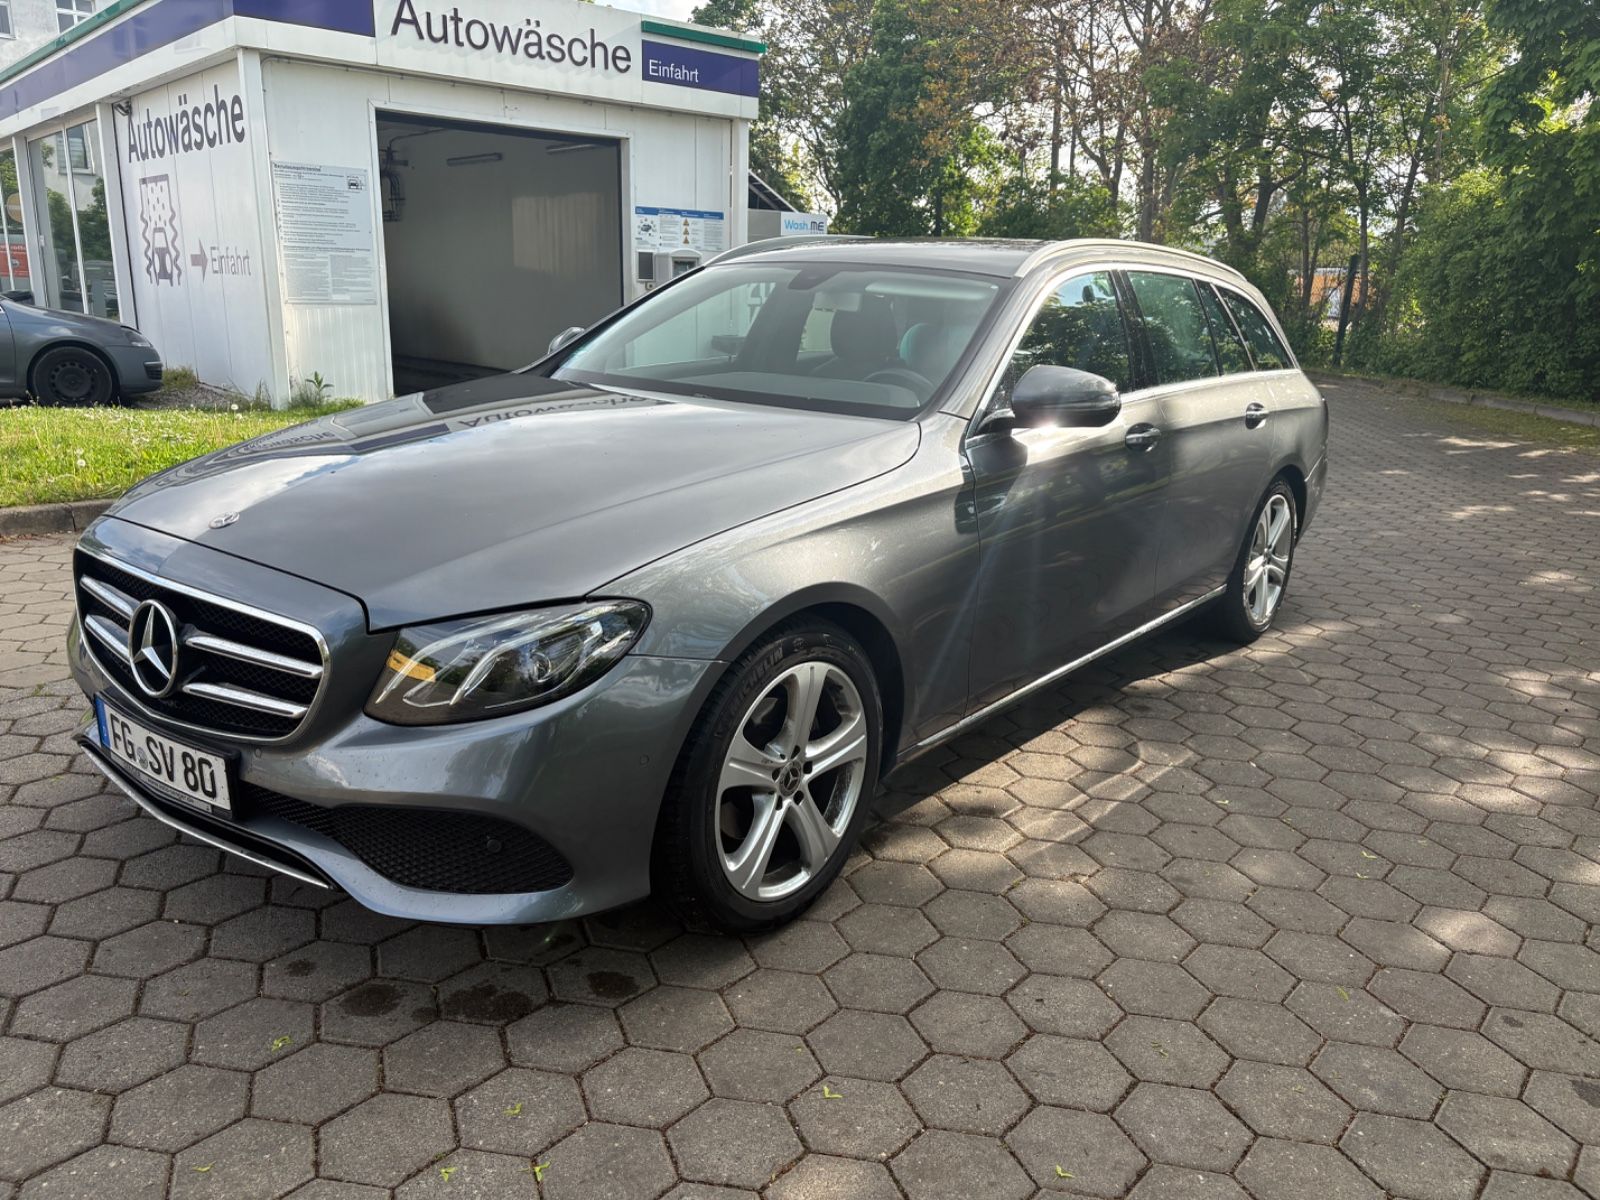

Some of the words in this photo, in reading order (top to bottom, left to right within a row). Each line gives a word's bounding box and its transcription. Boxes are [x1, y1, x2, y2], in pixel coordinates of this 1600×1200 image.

[390, 0, 632, 74] Autowäsche
[648, 58, 700, 83] Einfahrt
[128, 84, 246, 164] Autowäsche
[210, 245, 252, 277] Einfahrt
[110, 712, 137, 763] FG
[145, 735, 175, 783] SV
[181, 751, 217, 799] 80
